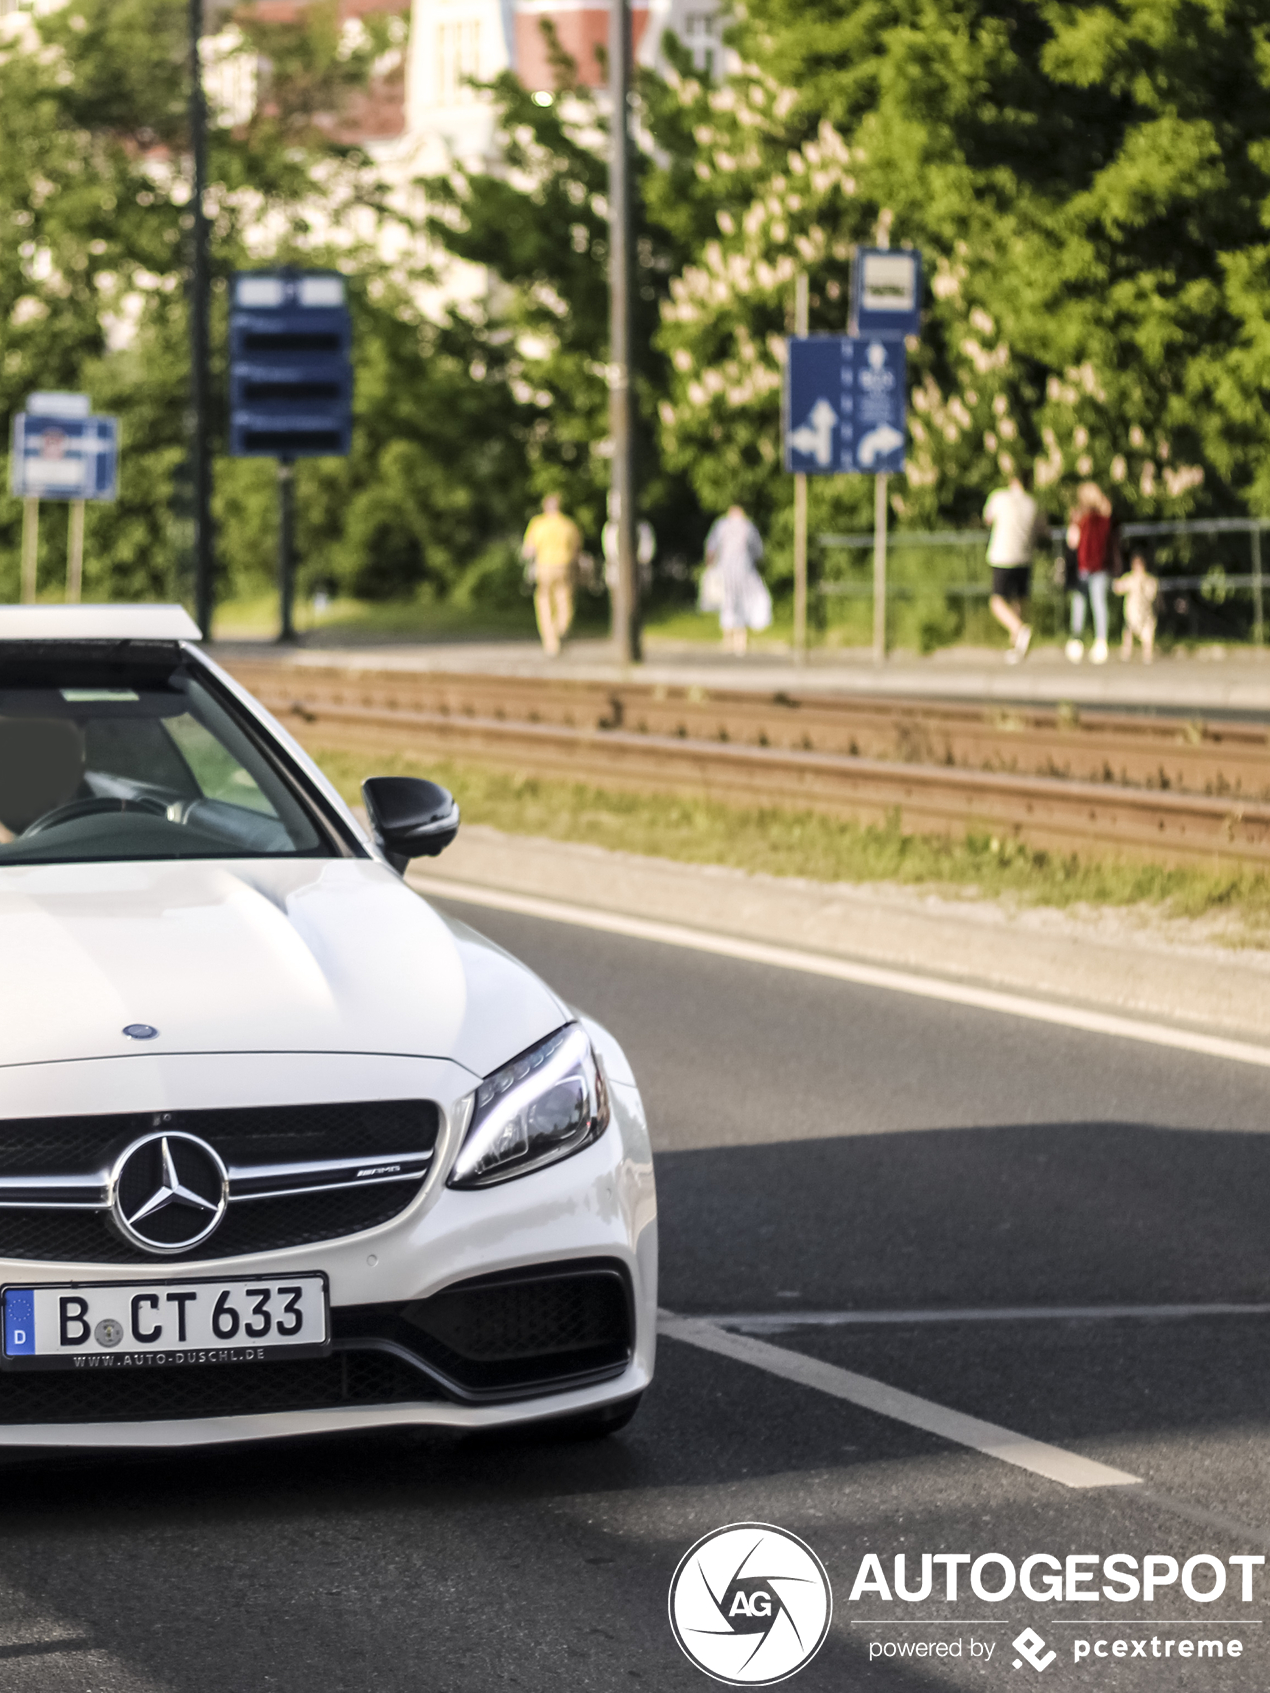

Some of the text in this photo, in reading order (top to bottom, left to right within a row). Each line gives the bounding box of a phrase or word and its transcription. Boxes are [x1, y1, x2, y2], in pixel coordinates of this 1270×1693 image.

[59, 1286, 303, 1347] B CT 633
[14, 1330, 27, 1345] D
[73, 1349, 265, 1368] WWW.AUTO-DUSCHL.DE
